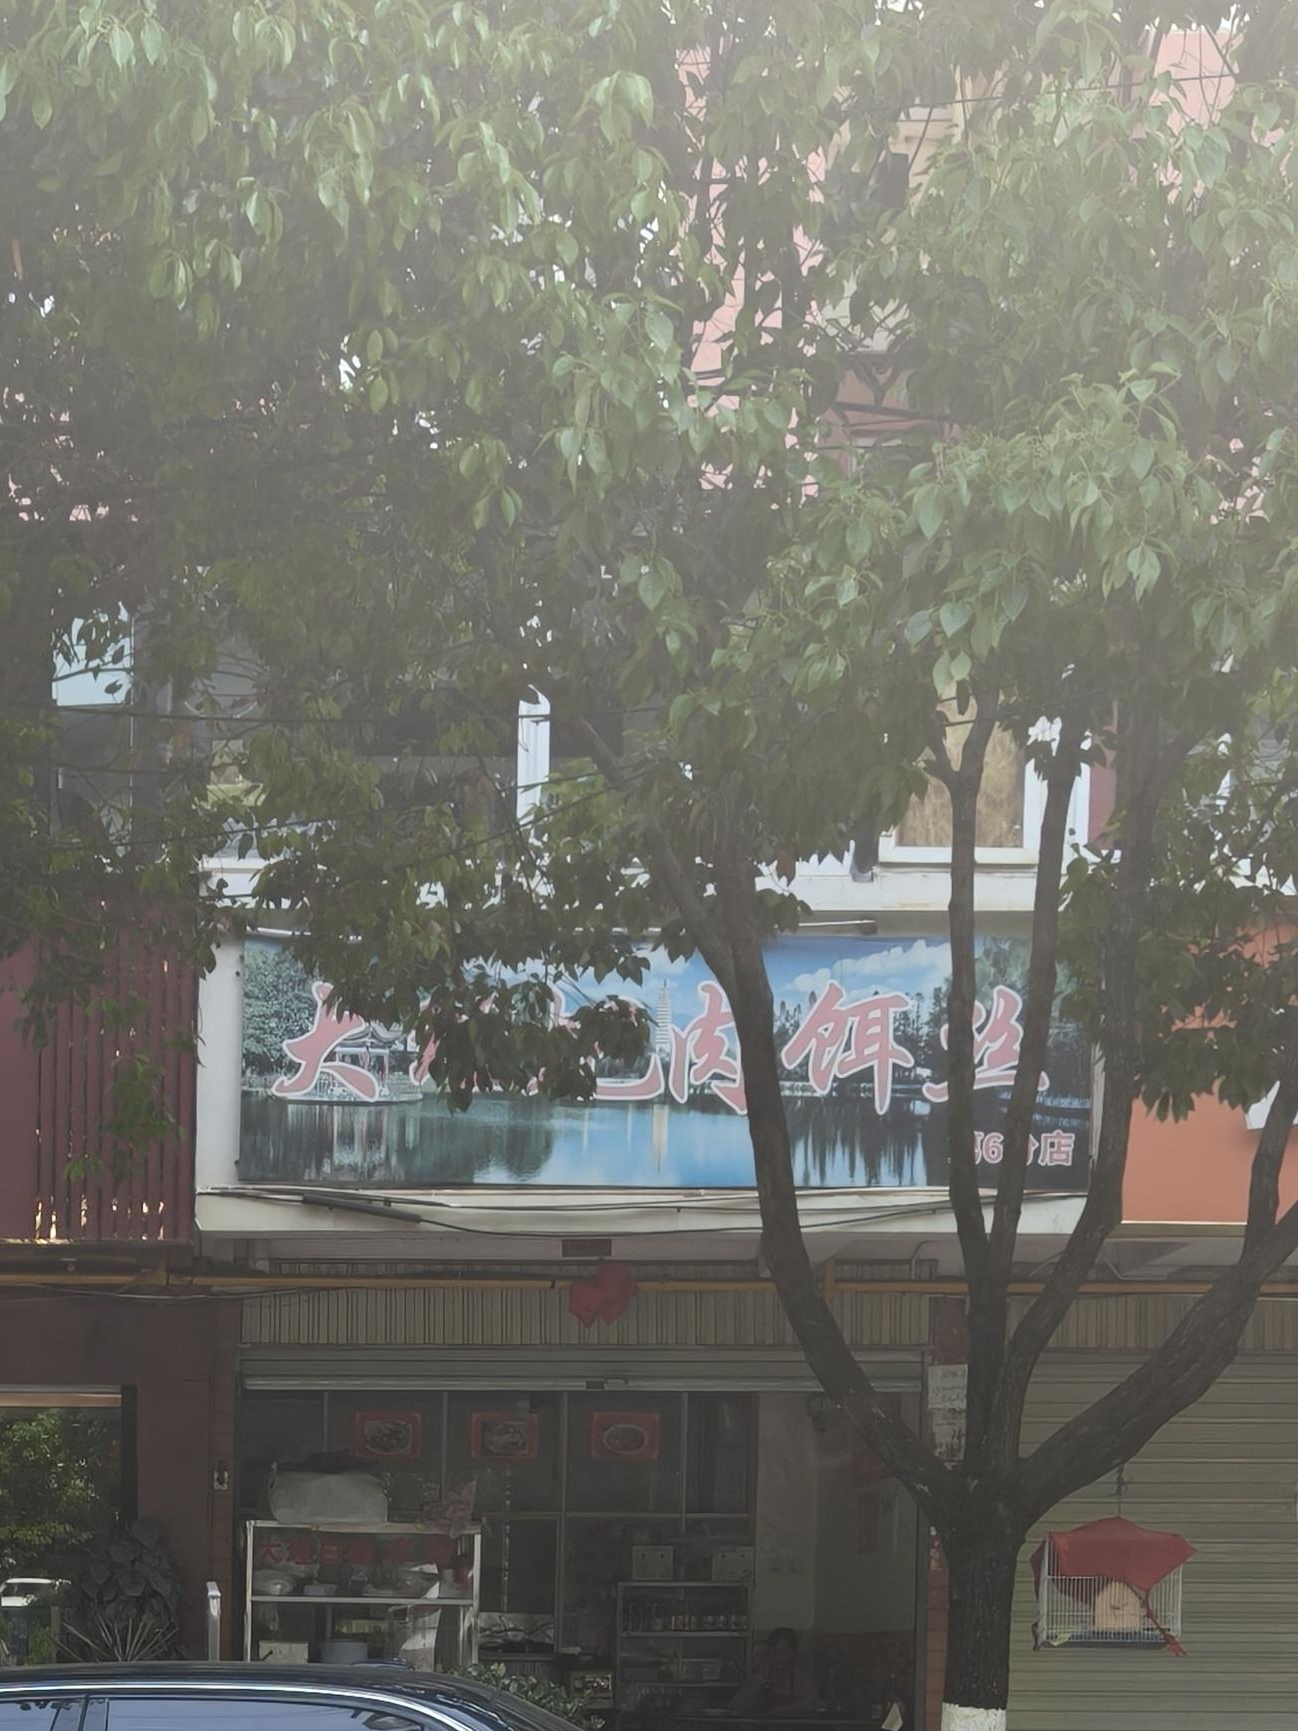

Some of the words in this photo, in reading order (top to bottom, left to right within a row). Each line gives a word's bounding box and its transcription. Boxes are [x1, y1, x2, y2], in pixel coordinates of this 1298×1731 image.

[270, 980, 1050, 1116] 大肉饵丝
[948, 1129, 1076, 1167] 6店
